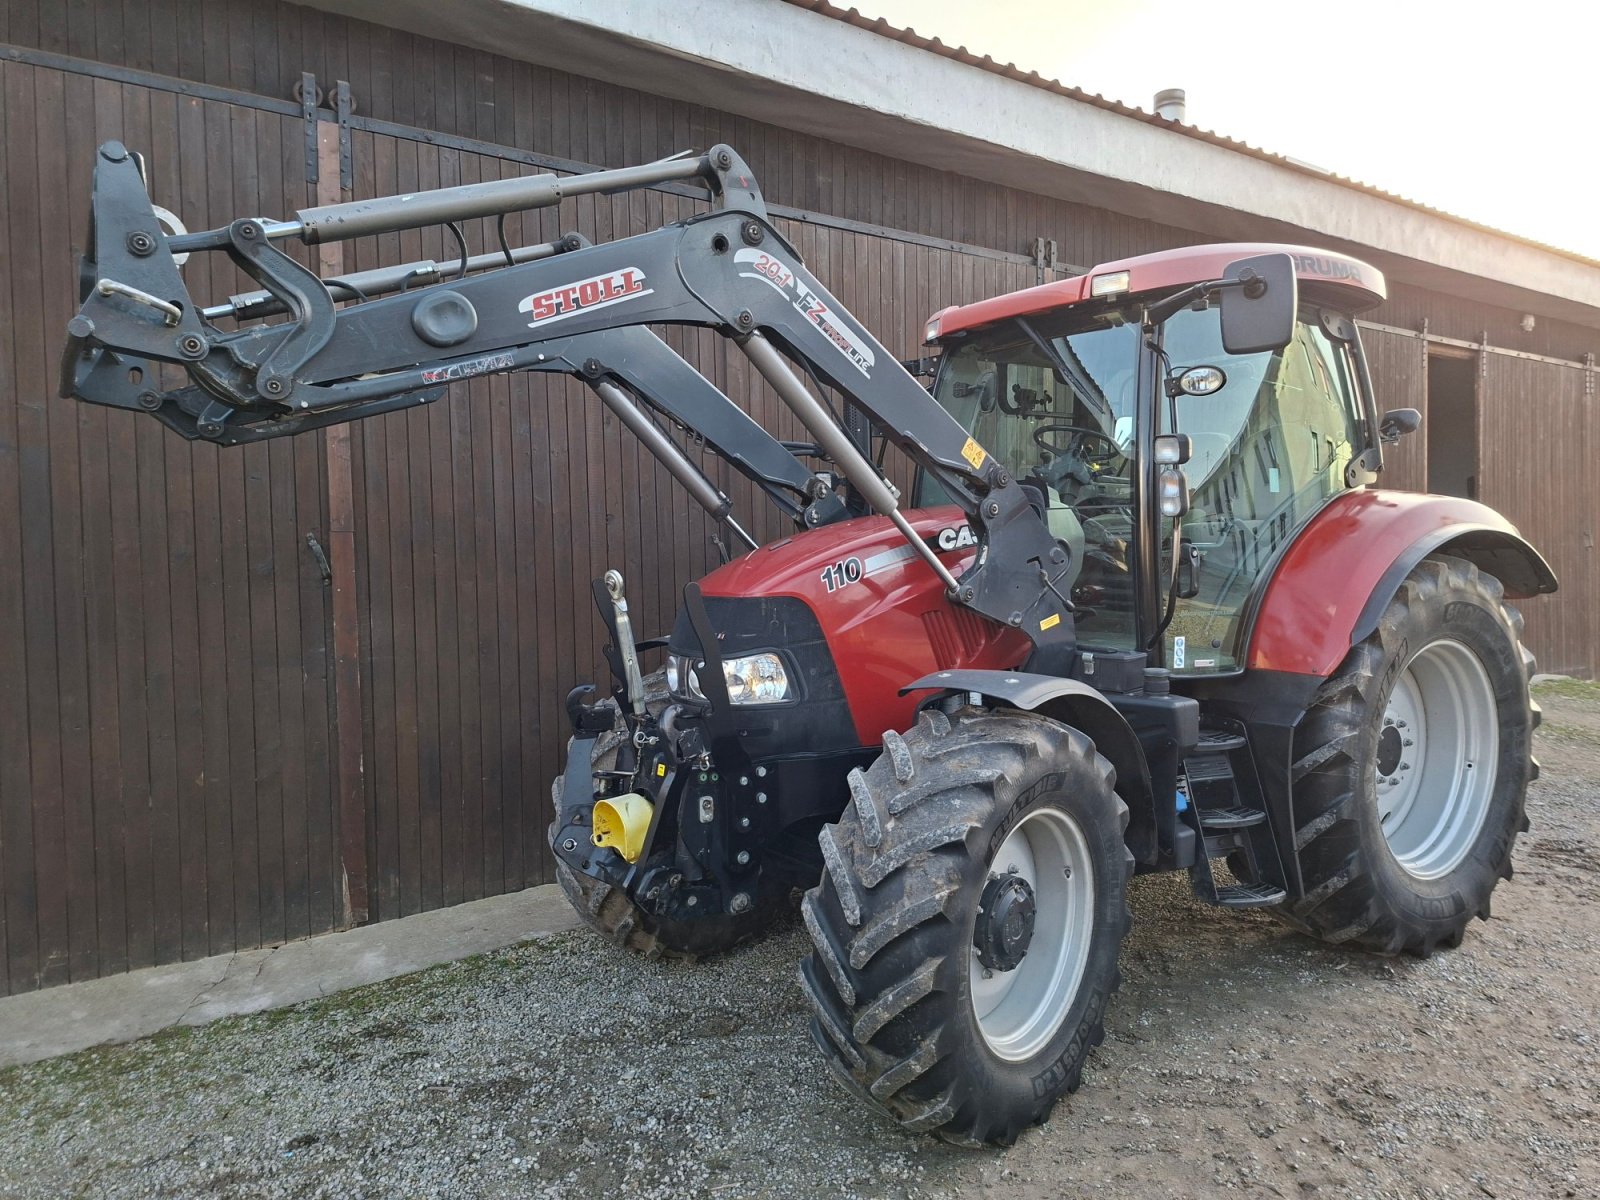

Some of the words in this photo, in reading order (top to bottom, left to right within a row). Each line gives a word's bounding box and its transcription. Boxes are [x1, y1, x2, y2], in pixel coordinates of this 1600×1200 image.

[753, 254, 792, 288] 20.1
[532, 270, 643, 320] STOLL
[820, 556, 862, 593] 110
